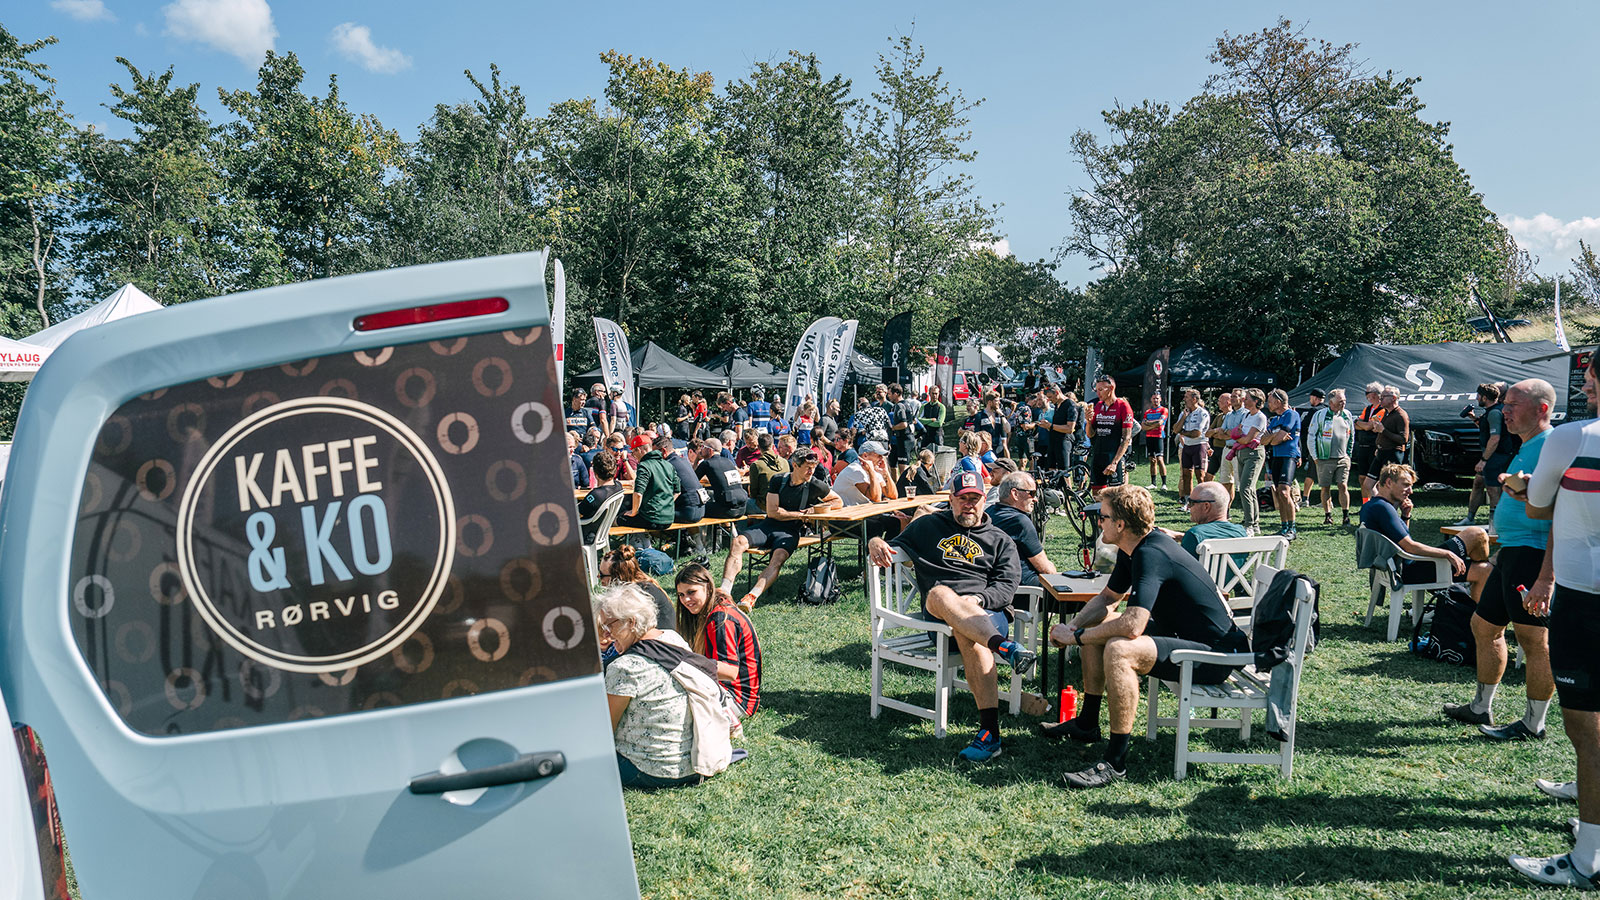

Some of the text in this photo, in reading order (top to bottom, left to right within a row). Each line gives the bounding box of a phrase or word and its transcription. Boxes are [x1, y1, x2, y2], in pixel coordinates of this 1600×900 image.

[795, 362, 808, 387] nyt
[827, 362, 836, 384] nyt
[235, 435, 383, 512] KAFFE
[245, 494, 393, 593] & KO
[255, 590, 400, 630] RØRVIG
